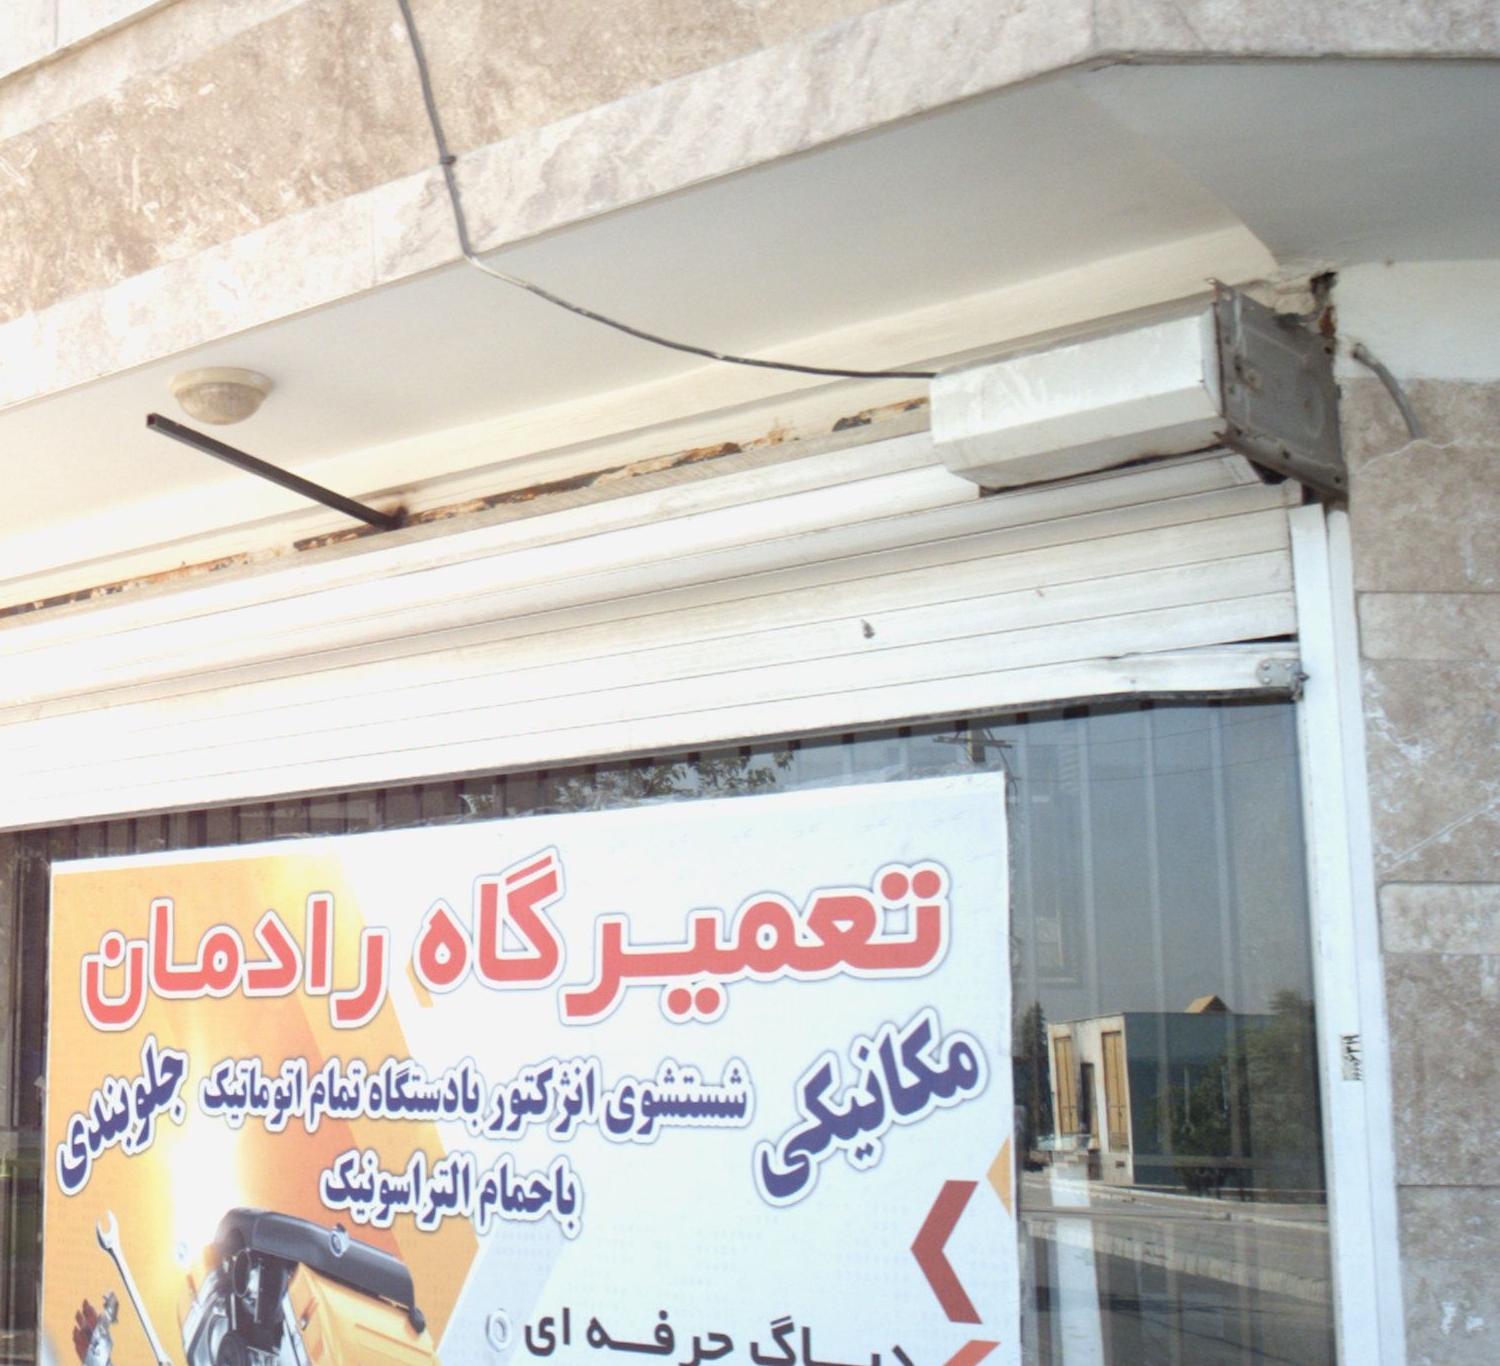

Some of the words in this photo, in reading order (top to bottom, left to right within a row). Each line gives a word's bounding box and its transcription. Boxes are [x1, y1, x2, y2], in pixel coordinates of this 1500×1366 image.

[85, 899, 384, 1024] رادمان
[60, 1046, 184, 1190] جلوبندی
[203, 1066, 303, 1126] اتوماتیک
[309, 1067, 362, 1124] تمام
[488, 1066, 595, 1134] انژکتور
[604, 1067, 748, 1136] شستشوی
[760, 1019, 980, 1199] مکانیکی
[324, 1154, 471, 1227] التراسونیک
[524, 1306, 571, 1357] ای
